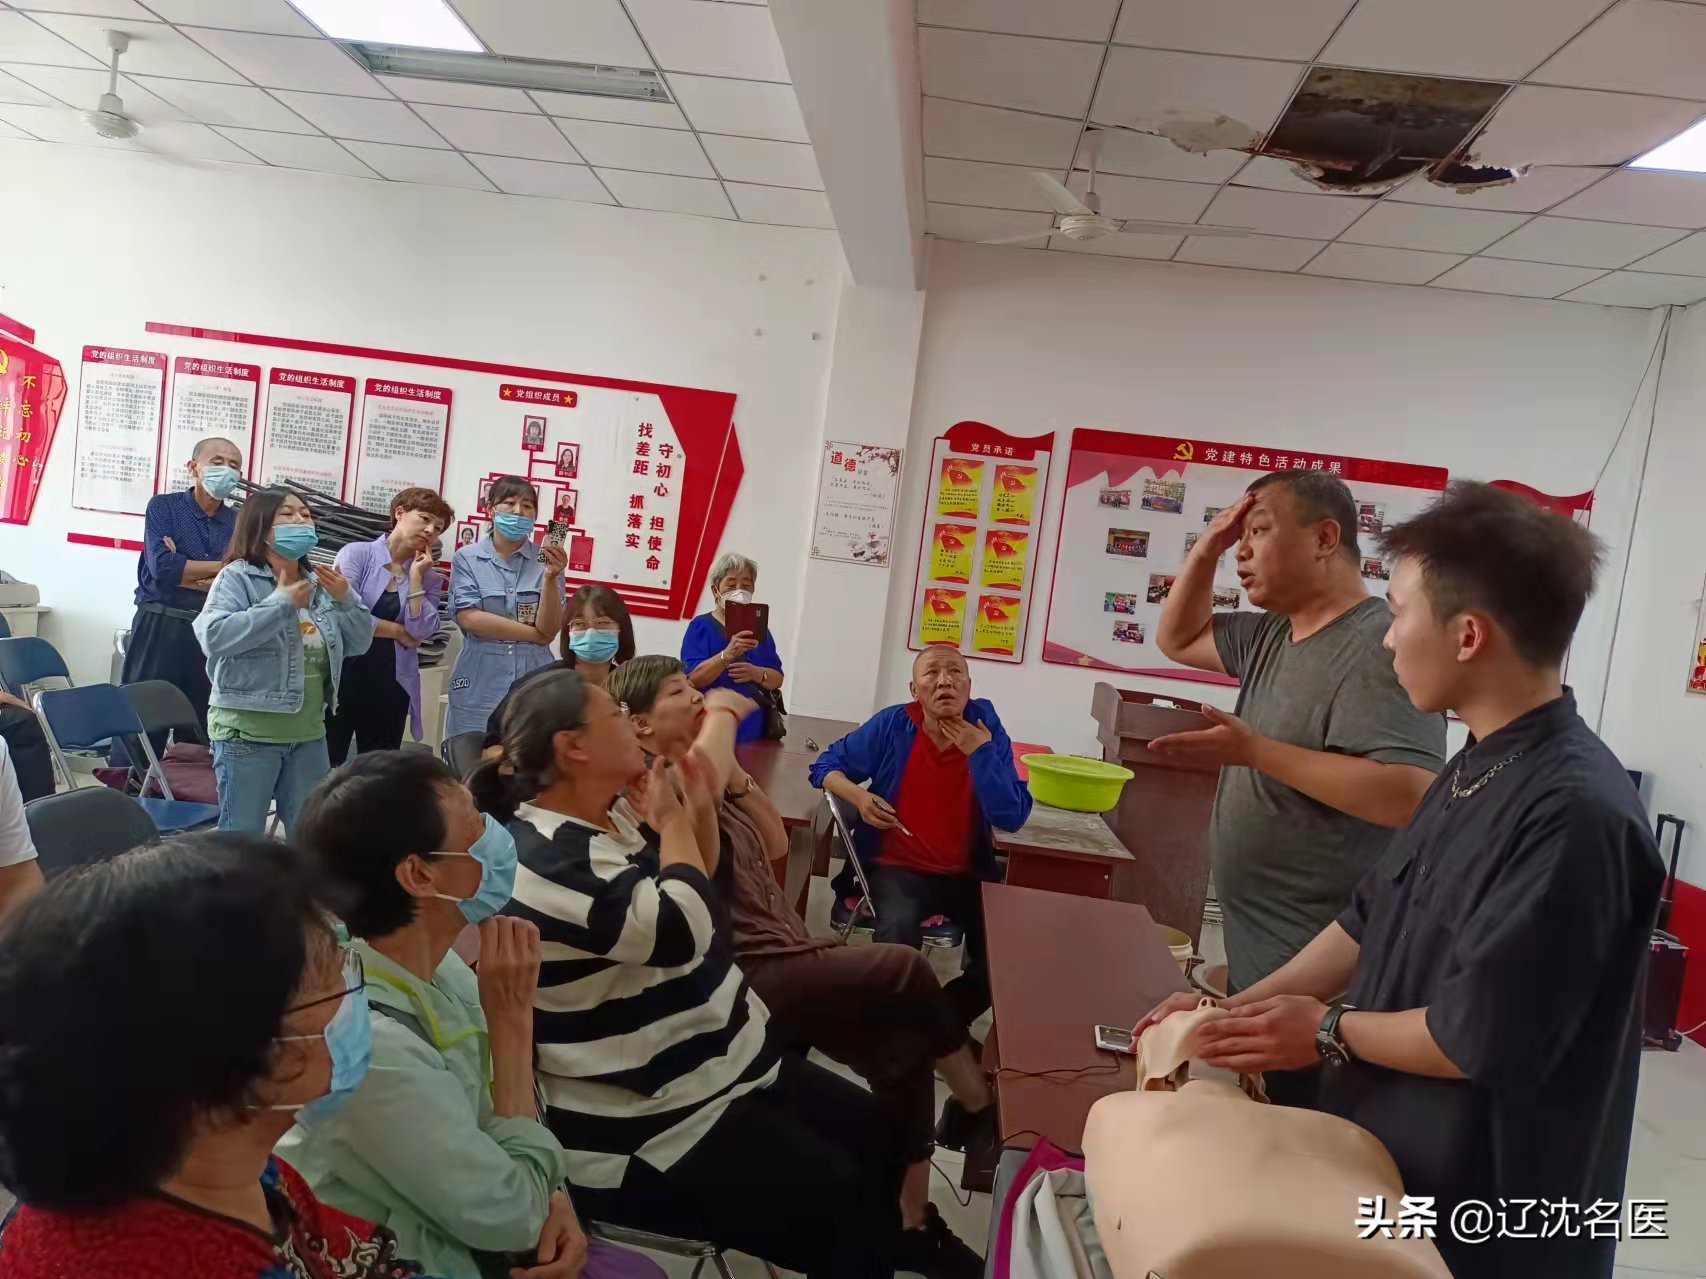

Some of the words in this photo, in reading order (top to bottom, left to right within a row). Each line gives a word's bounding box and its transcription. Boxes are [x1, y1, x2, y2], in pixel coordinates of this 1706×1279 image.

[91, 350, 156, 365] 党的组织生活制度
[183, 361, 250, 377] 党的组织生活制度
[278, 373, 345, 389] 党的组织生活制度
[374, 383, 442, 400] 党的组织生活制度
[515, 389, 560, 403] 党组织成员
[13, 375, 37, 467] 不忘初心
[632, 422, 654, 476] 找差距
[971, 442, 1014, 456] 党员承诺
[653, 443, 674, 498] 守初心
[1204, 447, 1342, 475] 党建特色活动成果
[625, 494, 645, 549] 抓落实
[645, 515, 665, 571] 担使命
